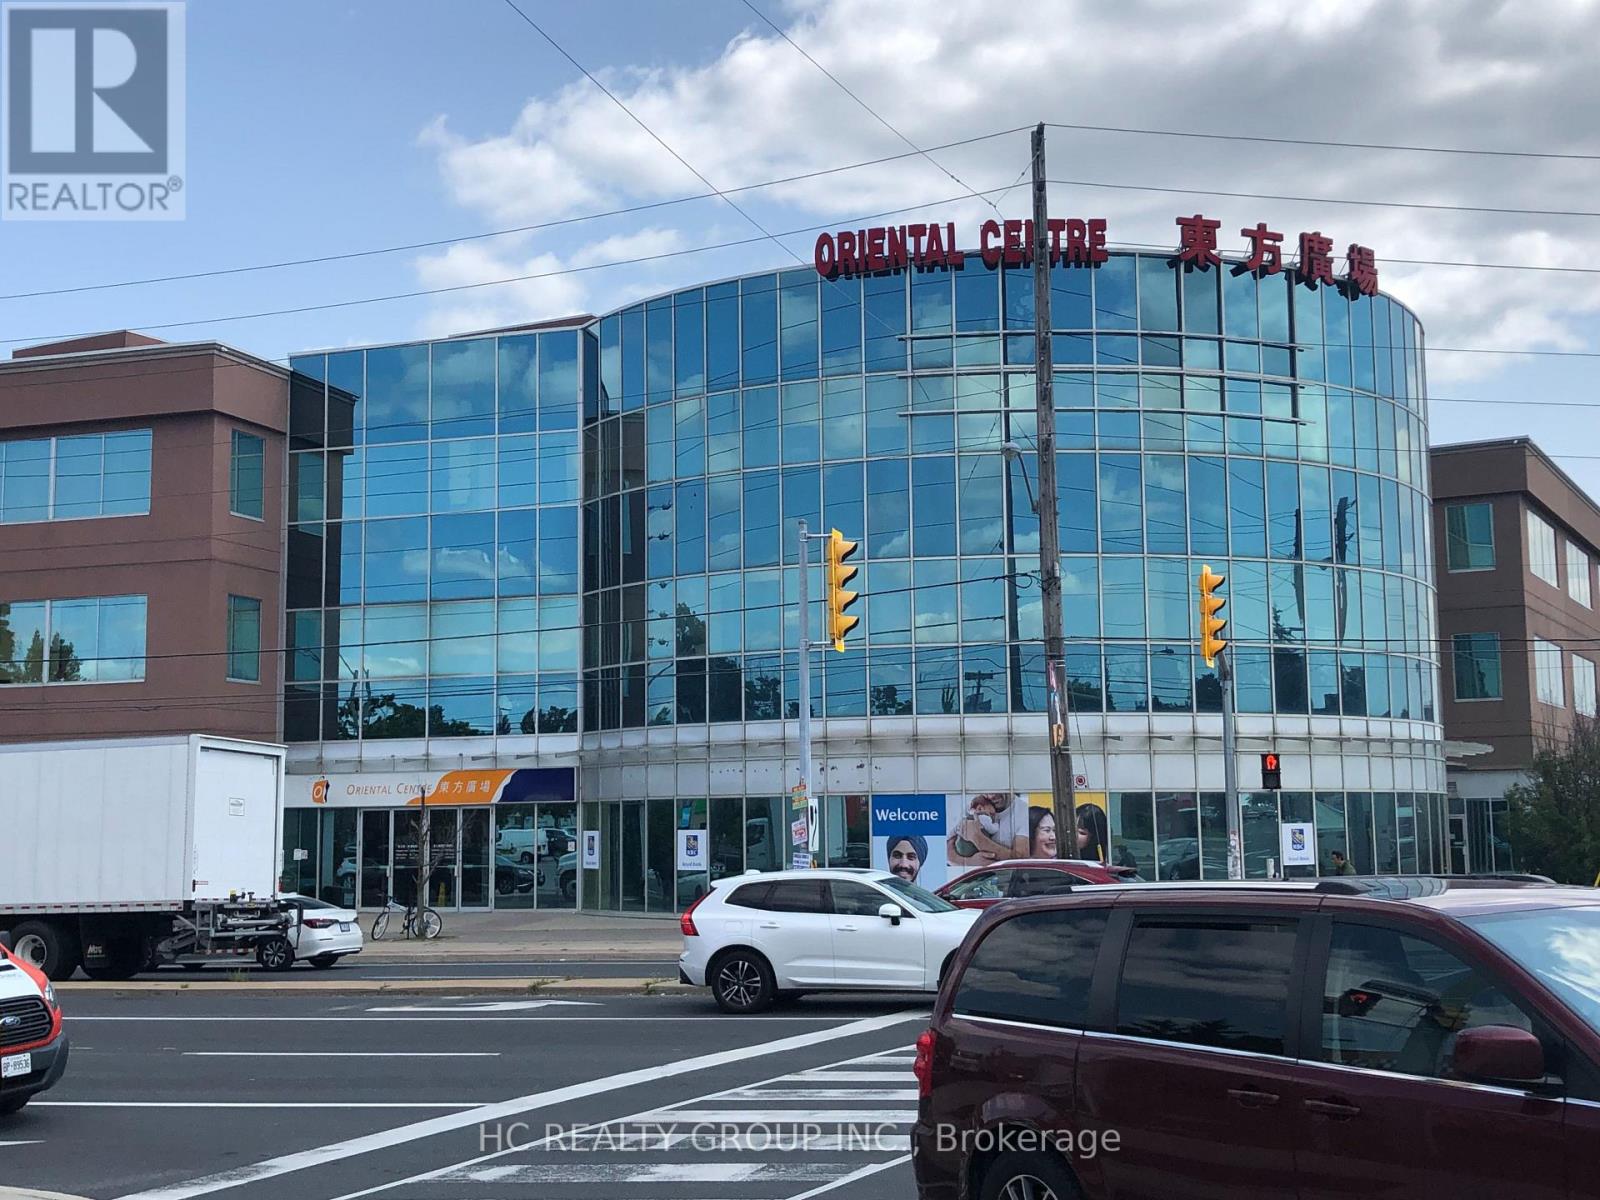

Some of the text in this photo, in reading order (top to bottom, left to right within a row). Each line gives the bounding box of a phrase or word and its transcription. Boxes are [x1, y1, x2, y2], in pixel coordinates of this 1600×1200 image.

[814, 221, 965, 278] ORIENTAL
[1175, 213, 1379, 297] 東方廣場
[346, 783, 393, 795] ORIENTAL
[875, 807, 939, 821] Welcome
